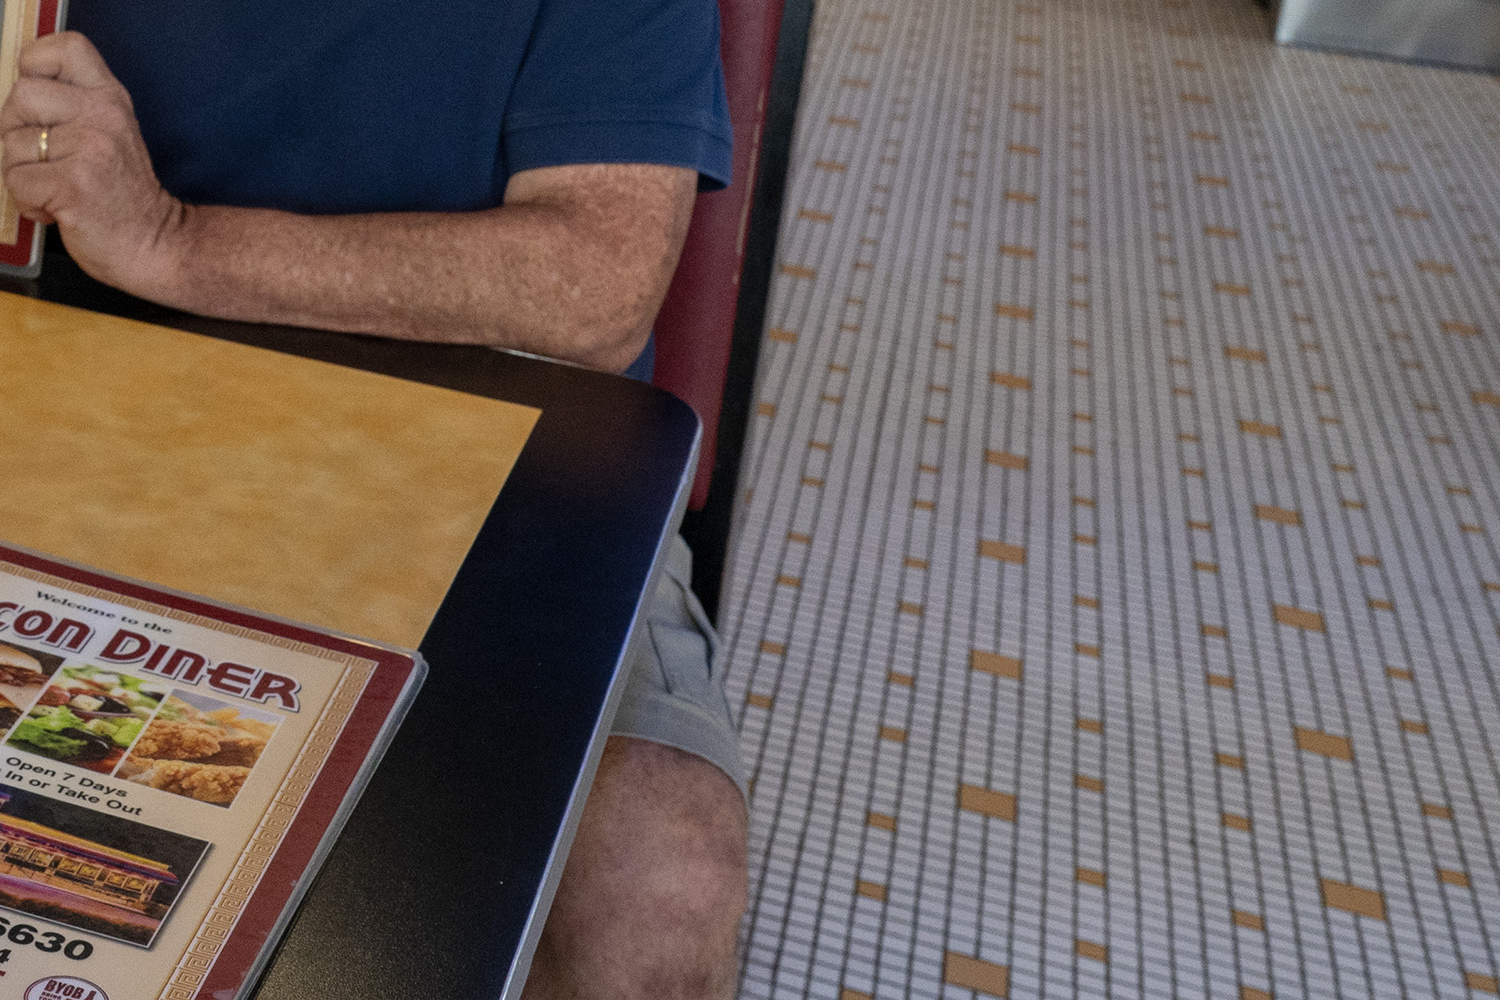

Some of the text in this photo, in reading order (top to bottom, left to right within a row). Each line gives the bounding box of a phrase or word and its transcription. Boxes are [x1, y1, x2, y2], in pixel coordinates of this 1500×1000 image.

[36, 589, 173, 636] Welcome to the
[99, 627, 302, 714] DINER
[4, 769, 24, 783] In
[28, 778, 52, 791] or
[56, 784, 100, 806] Take
[105, 798, 144, 818] Out
[5, 756, 60, 780] Open
[62, 772, 76, 782] 7
[78, 776, 129, 800] Days
[44, 979, 85, 1000] BYOB
